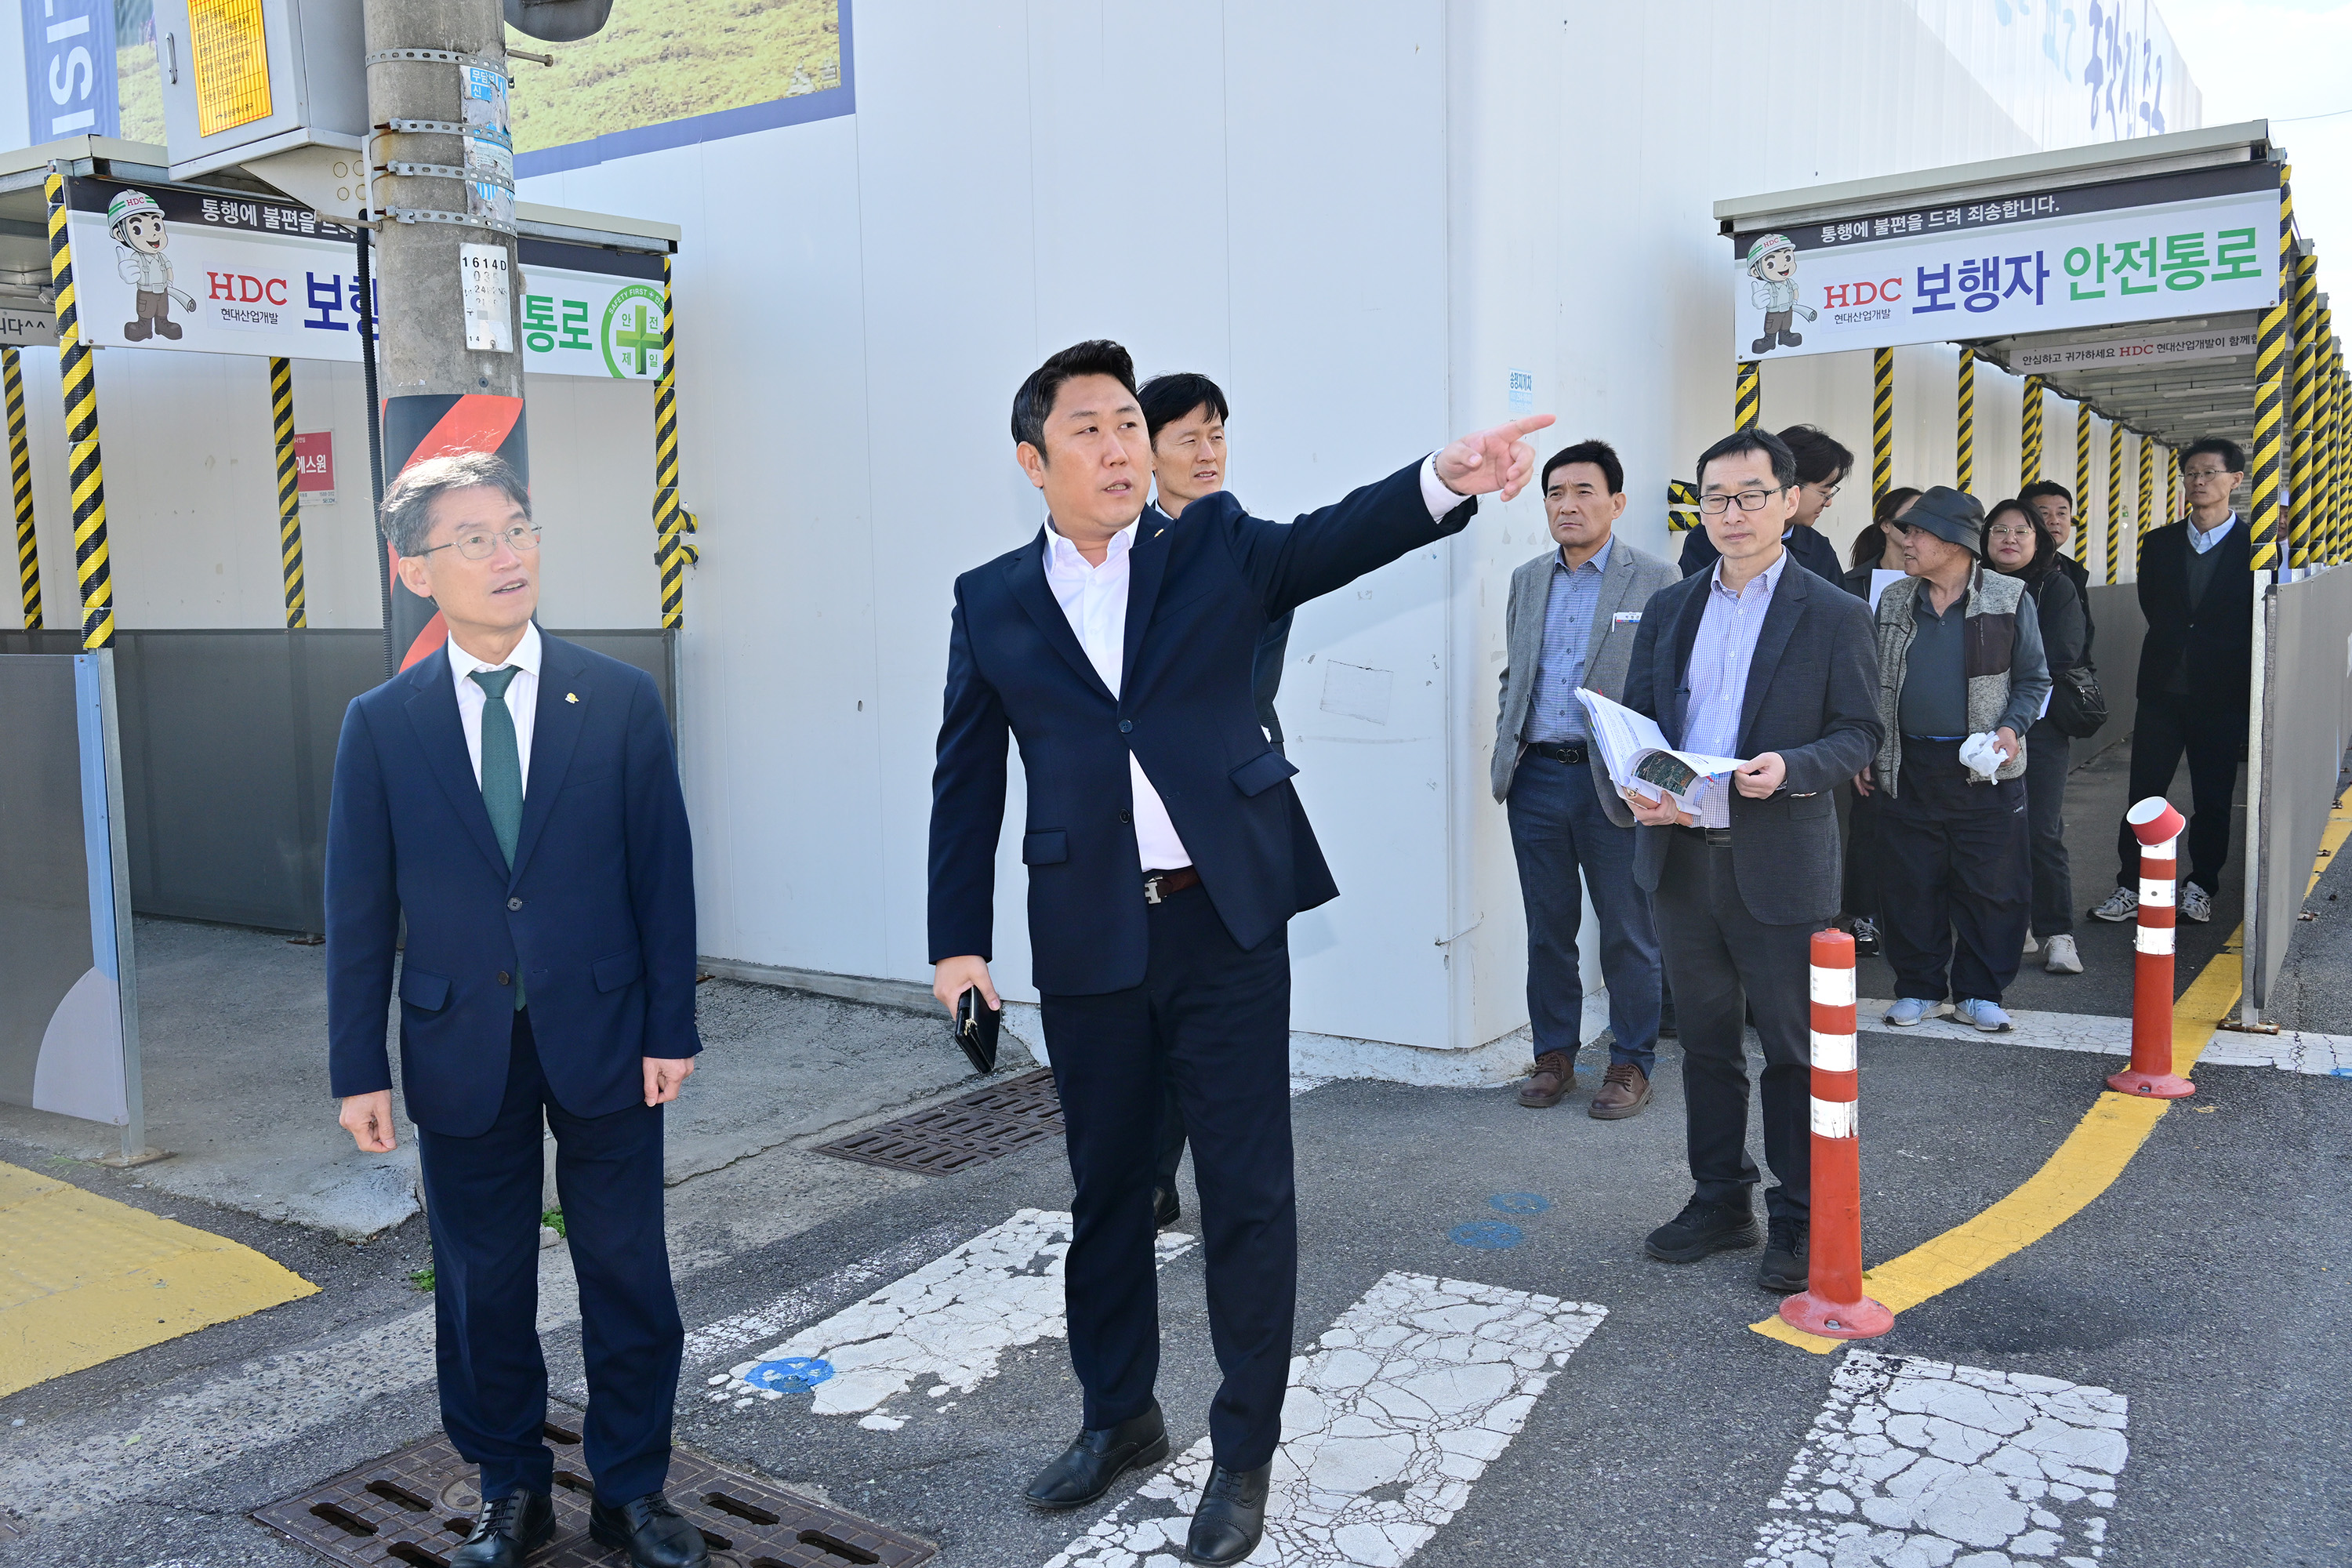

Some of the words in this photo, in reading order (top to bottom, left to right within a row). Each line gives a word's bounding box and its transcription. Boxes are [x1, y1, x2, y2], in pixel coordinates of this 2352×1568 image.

[44, 0, 95, 135] ISI
[126, 197, 145, 206] HDC
[201, 198, 258, 227] 통행에
[263, 206, 315, 234] 불편을
[1820, 220, 1869, 243] 통행에
[1874, 213, 1923, 235] 불편을
[1928, 208, 1961, 227] 드려
[1967, 195, 2060, 222] 죄송합니다.
[1763, 237, 1780, 249] HDC
[462, 256, 507, 271] 1614D
[1912, 250, 2050, 314] 보행자
[2063, 227, 2262, 301] 안전통로
[206, 271, 288, 307] HDC
[1824, 278, 1902, 310] HDC
[608, 292, 628, 314] SAFETY
[629, 288, 648, 296] FIRST
[220, 307, 279, 325] 현대산업개발
[522, 294, 593, 353] 통로
[622, 314, 631, 327] 안
[649, 316, 659, 330] 전
[1834, 309, 1891, 325] 현대산업개발
[622, 352, 632, 366] 제
[648, 354, 658, 368] 일
[2022, 353, 2062, 366] 안심하고
[2065, 348, 2115, 362] 귀가하세요
[2119, 344, 2154, 358] HDC
[2156, 337, 2225, 354] 현대산업개발이
[1510, 372, 1532, 391] 송정지게차
[296, 454, 327, 474] 에스원
